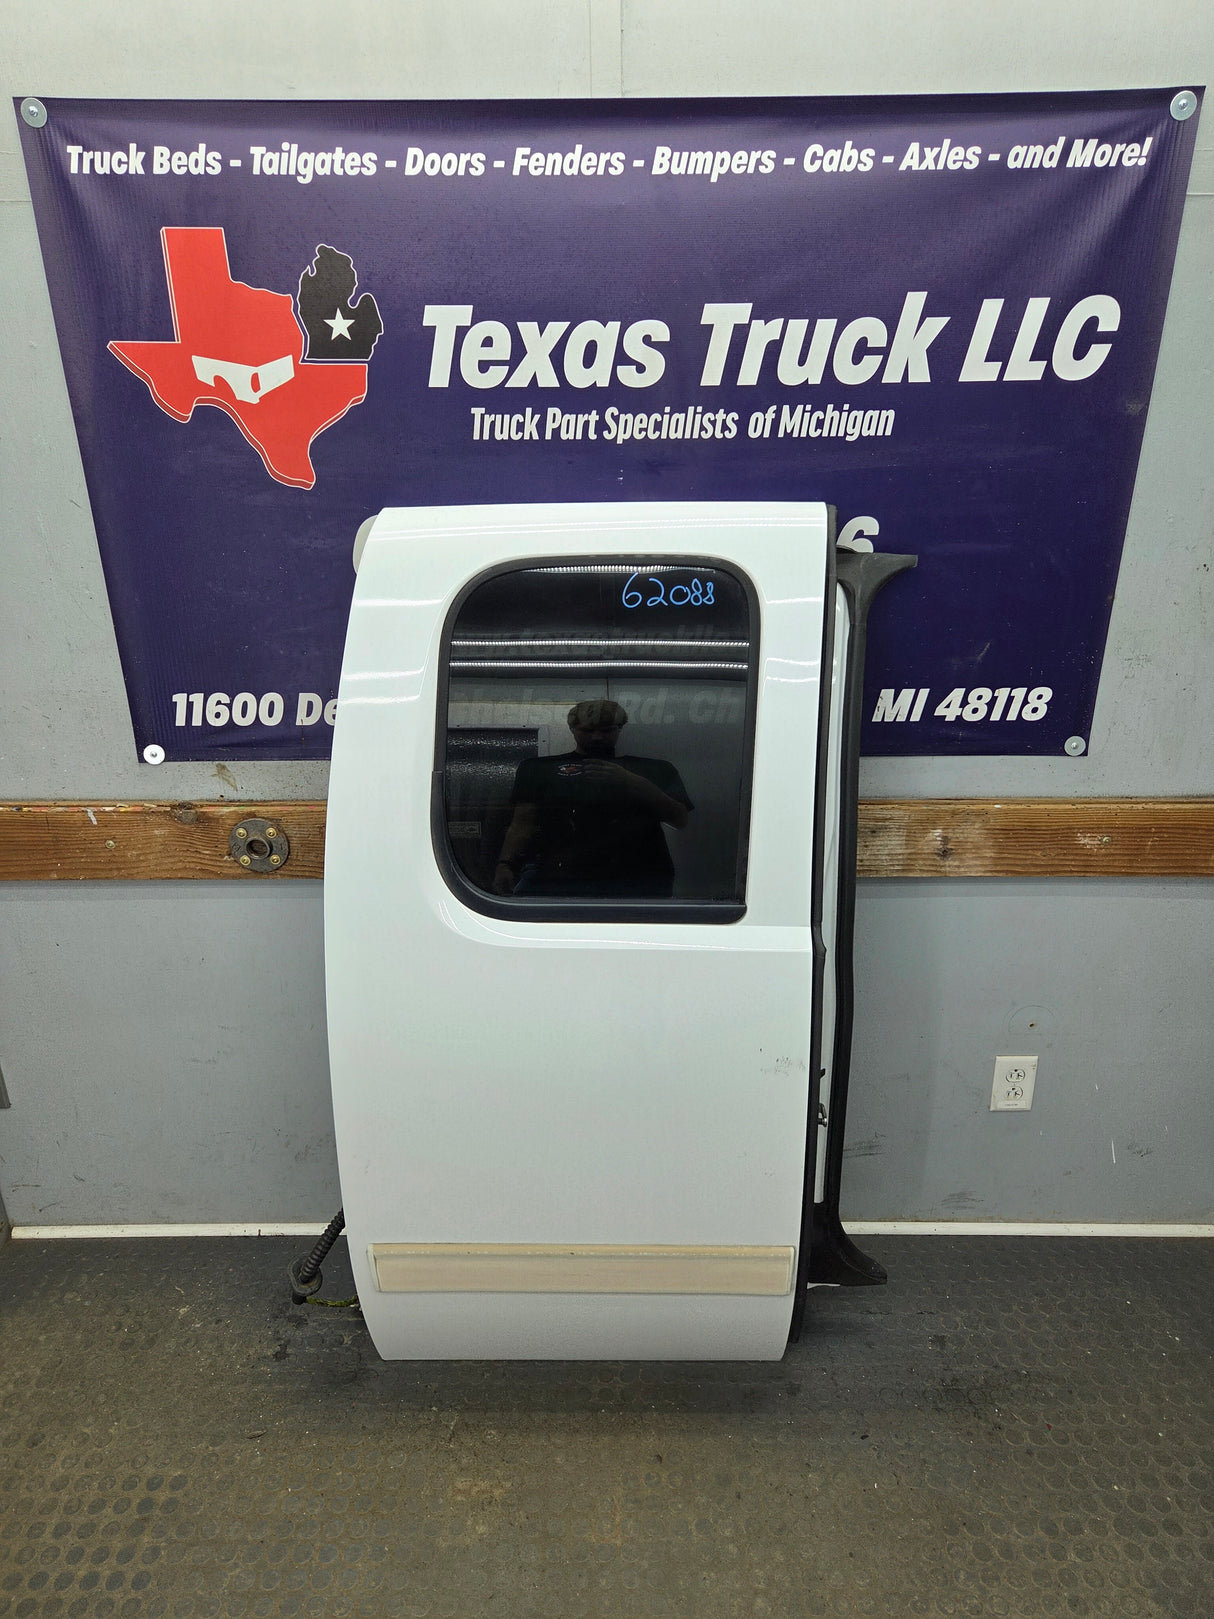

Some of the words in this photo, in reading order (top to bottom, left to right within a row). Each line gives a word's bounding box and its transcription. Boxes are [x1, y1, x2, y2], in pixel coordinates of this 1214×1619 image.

[67, 143, 145, 174] Truck
[153, 143, 221, 175] Beds
[250, 142, 377, 184] Tailgates
[405, 147, 486, 176] Doors
[513, 144, 625, 175] Fenders
[652, 146, 776, 182] Bumpers
[804, 141, 875, 172] Cabs
[899, 139, 981, 170] Axles
[1008, 137, 1065, 168] and
[1066, 137, 1153, 167] More!
[423, 305, 670, 388] Texas
[700, 292, 951, 386] Truck
[959, 295, 1120, 381] LLC
[471, 408, 540, 440] Truck
[545, 408, 599, 440] Part
[603, 406, 738, 444] Specialists
[748, 405, 776, 438] of
[778, 404, 895, 441] Michigan
[621, 573, 715, 609] 62088
[172, 693, 284, 726] 11600
[872, 689, 930, 721] MI
[934, 687, 1053, 721] 48118
